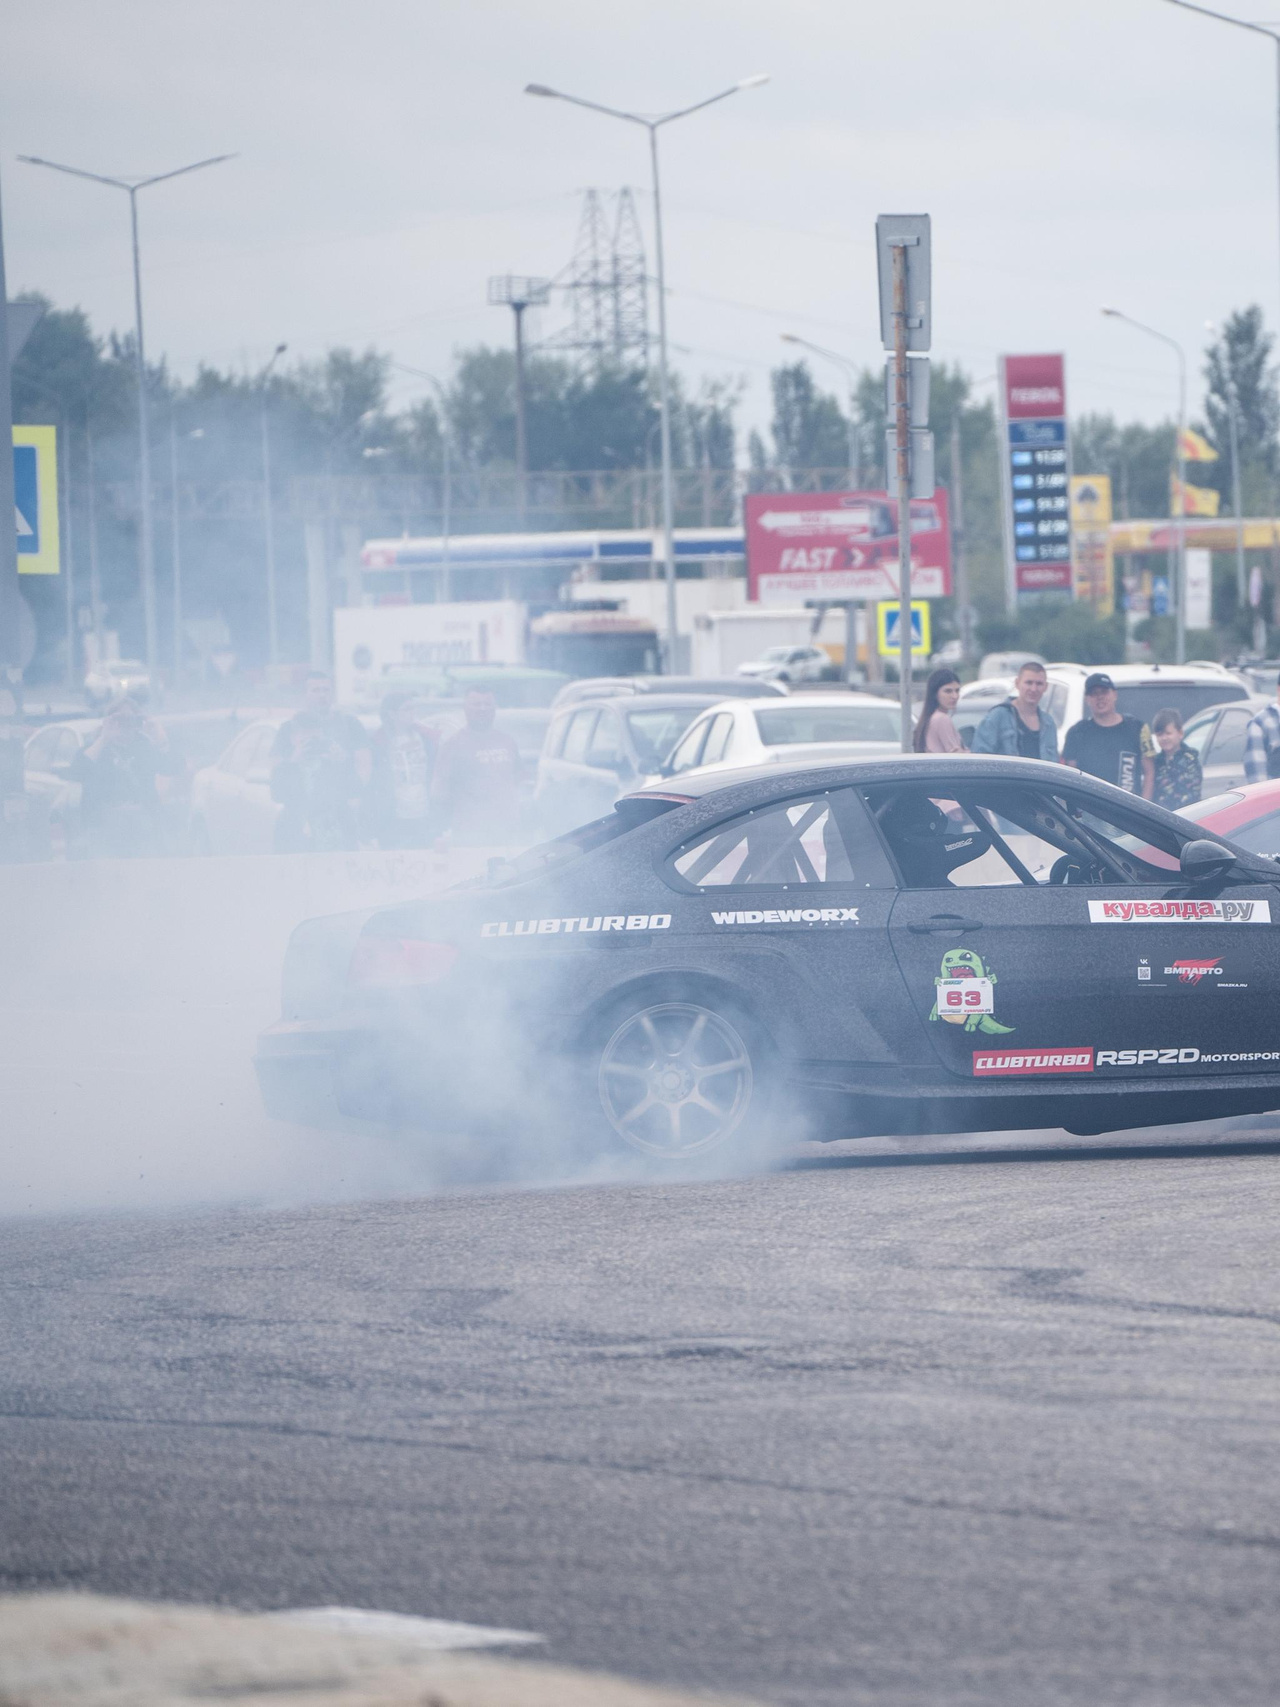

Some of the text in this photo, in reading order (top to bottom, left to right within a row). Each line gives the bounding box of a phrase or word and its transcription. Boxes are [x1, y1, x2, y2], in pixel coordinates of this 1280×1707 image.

[711, 908, 860, 925] WIDEWORX
[1103, 902, 1254, 921] кувалда.ру
[480, 914, 672, 938] CLUBTURBO
[1163, 966, 1224, 975] ВМПАВТО
[946, 991, 982, 1006] 63
[975, 1054, 1091, 1069] CLUBTURBO
[1096, 1048, 1200, 1066] RSPZD
